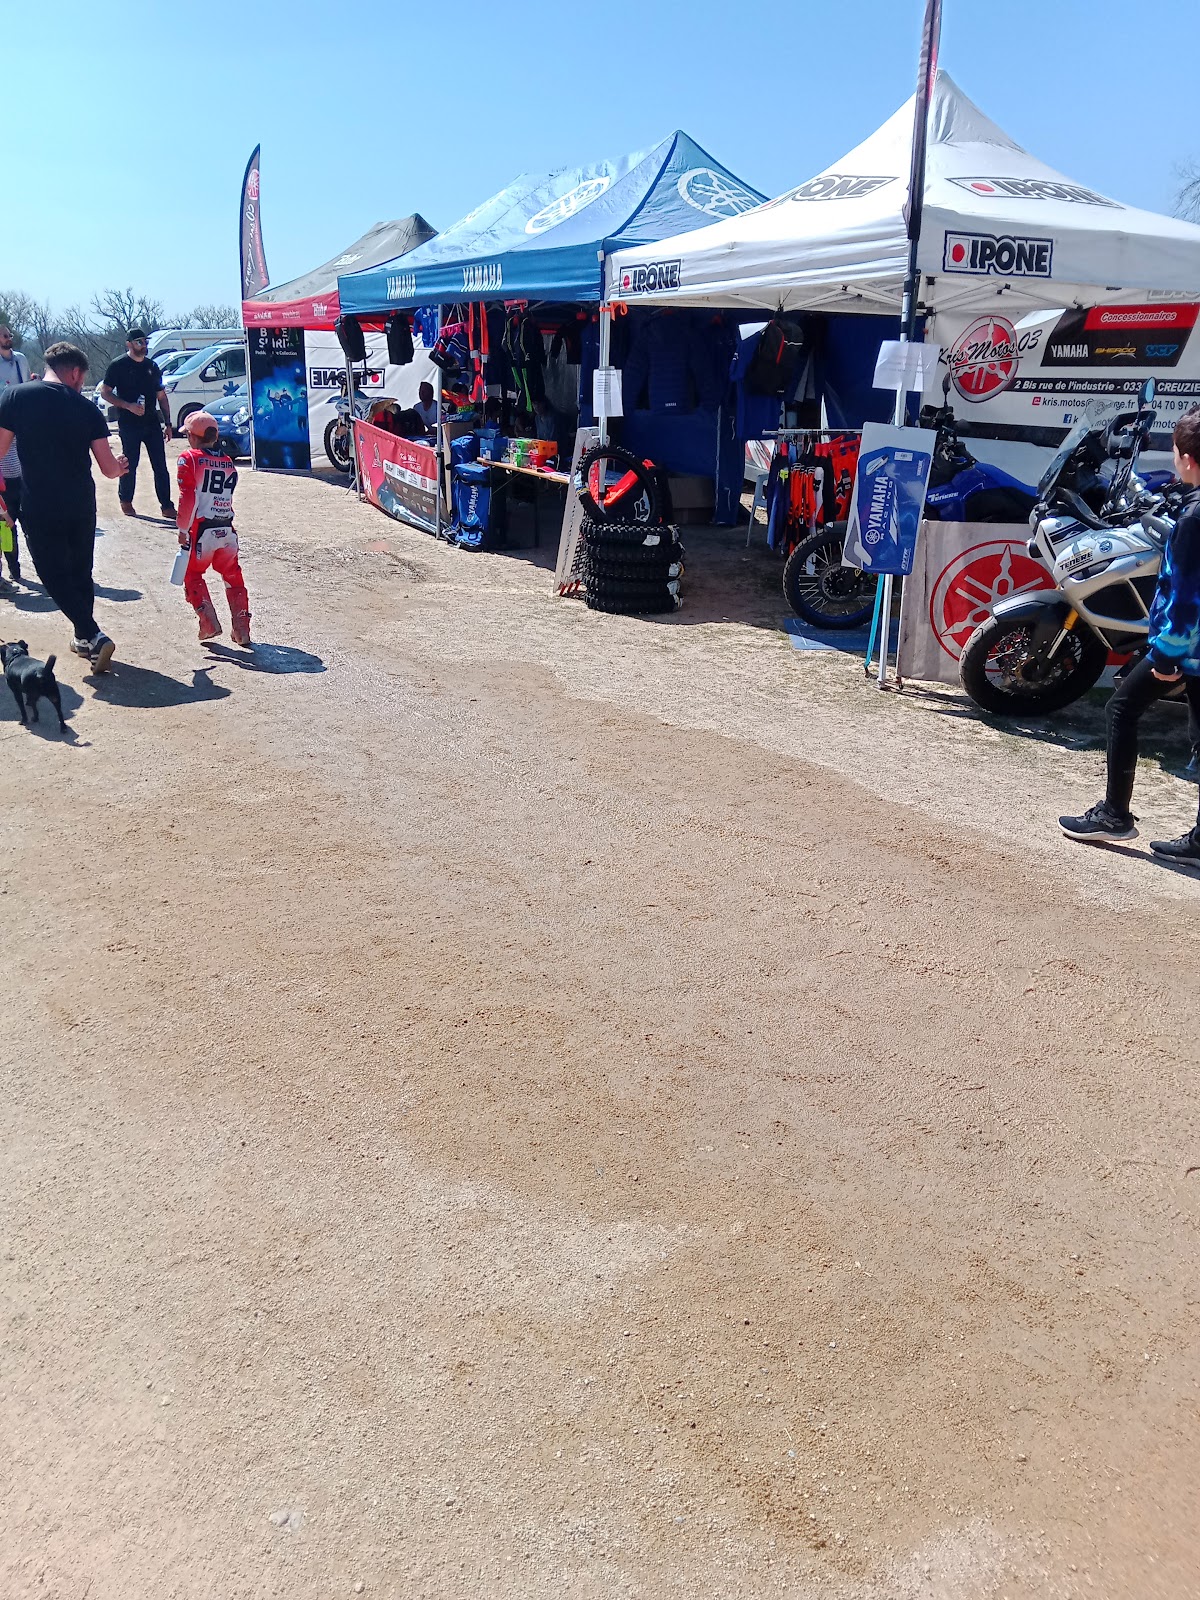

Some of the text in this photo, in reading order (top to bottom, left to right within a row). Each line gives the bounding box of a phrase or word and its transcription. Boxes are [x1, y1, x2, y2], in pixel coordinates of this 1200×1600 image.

[989, 180, 1114, 206] IPONE
[970, 239, 1049, 273] IPONE
[386, 274, 416, 301] YAMAHA
[461, 263, 503, 293] YAMAHA
[632, 264, 679, 292] IPONE
[1101, 310, 1178, 323] Concessionnaires
[260, 327, 288, 338] BE
[937, 347, 964, 366] Kris
[967, 340, 1016, 361] Motos
[1017, 329, 1043, 352] 03
[1050, 344, 1089, 358] YAMAHA
[1014, 380, 1022, 389] 2
[1022, 380, 1037, 390] Bis
[1038, 382, 1053, 390] rue
[1055, 381, 1066, 390] de
[1068, 381, 1115, 391] l'industrie
[1157, 382, 1200, 393] CREUZIE
[1151, 400, 1162, 409] 04
[1164, 400, 1175, 410] 70
[1177, 400, 1189, 410] 97
[201, 469, 238, 495] 184
[868, 476, 889, 529] YAMAHA
[880, 481, 893, 541] RACING
